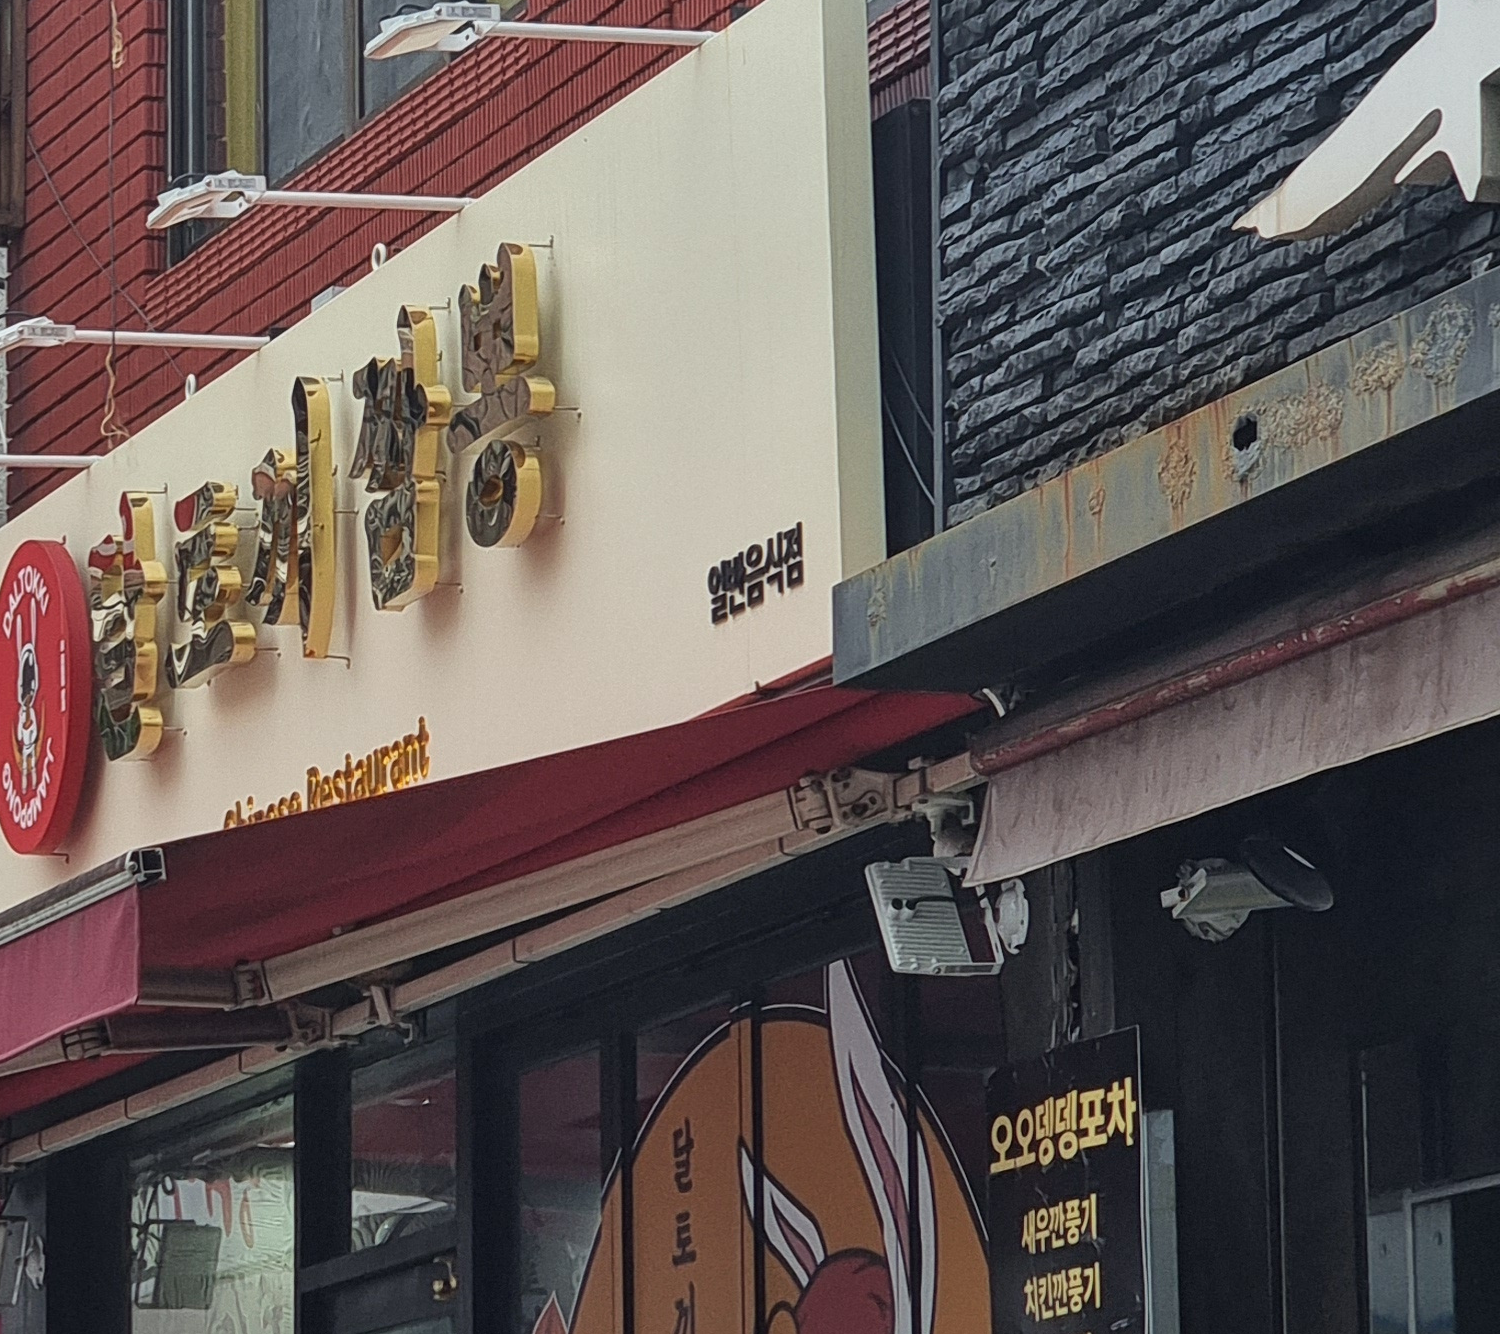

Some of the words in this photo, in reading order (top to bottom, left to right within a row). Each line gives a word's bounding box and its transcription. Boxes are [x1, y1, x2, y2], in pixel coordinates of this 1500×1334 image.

[2, 565, 50, 639] DALTOKKI
[708, 521, 804, 626] 일반음식점
[306, 716, 431, 811] Restaurant
[990, 1076, 1137, 1175] 오오뎅뎅포차
[1021, 1193, 1097, 1255] 새우깐풍기
[1023, 1261, 1100, 1323] 치킨깐풍기
